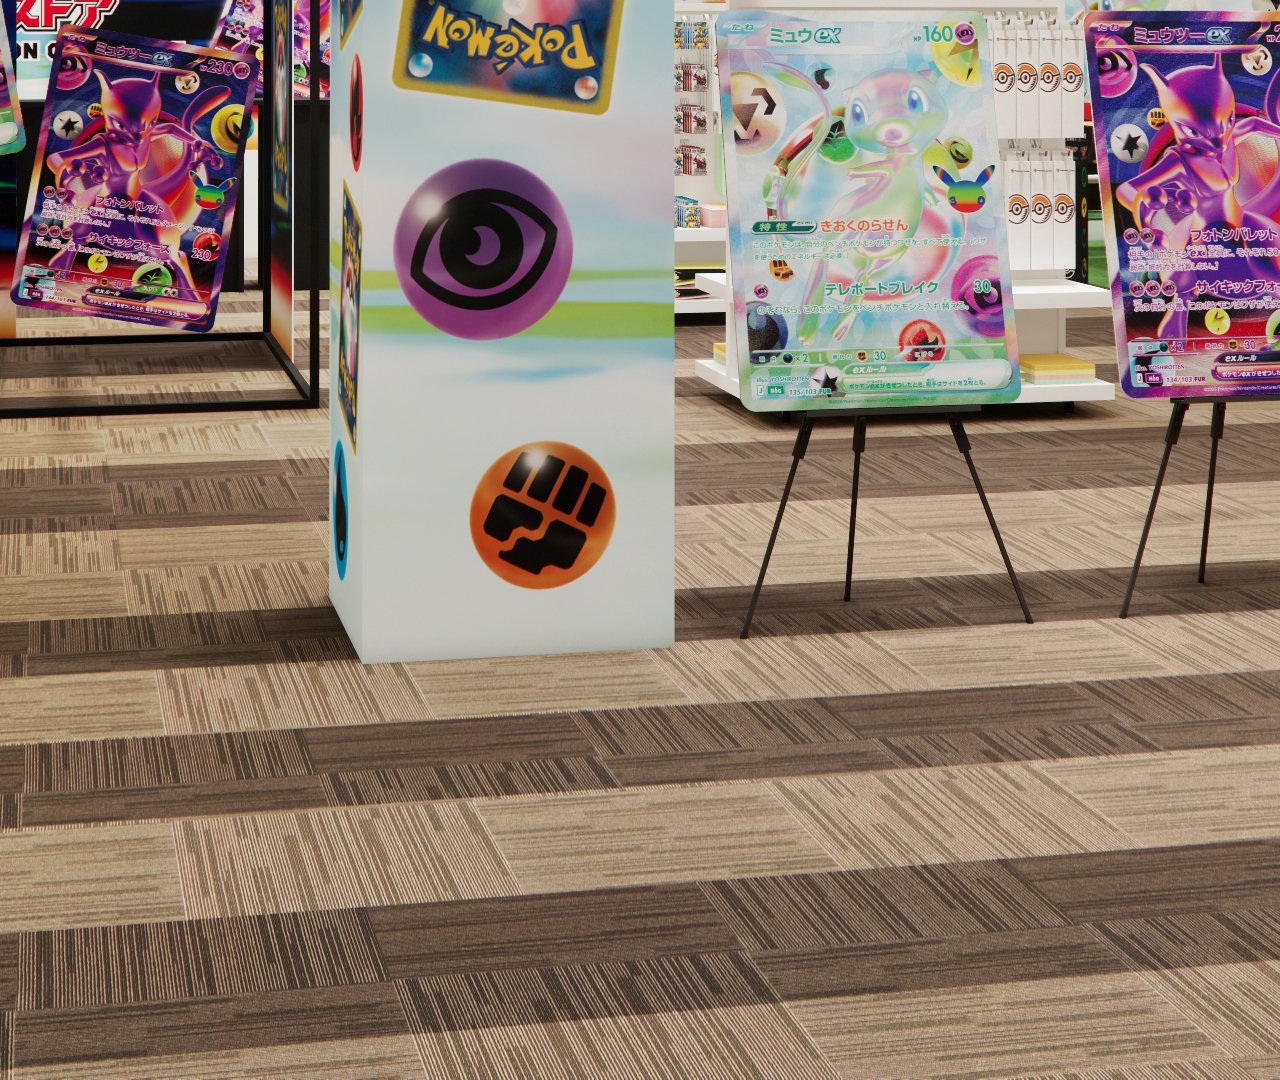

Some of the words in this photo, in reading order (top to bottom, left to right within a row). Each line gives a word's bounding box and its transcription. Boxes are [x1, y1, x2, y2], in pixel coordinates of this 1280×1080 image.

[770, 27, 841, 44] ミュウex
[923, 25, 953, 43] 160
[1133, 26, 1232, 44] ミュウツーex
[821, 220, 908, 233] きおくのらせん
[1191, 227, 1279, 241] フォトンバレット
[191, 249, 212, 261] 230
[825, 281, 939, 296] テレポートブレイク
[974, 280, 991, 293] 30
